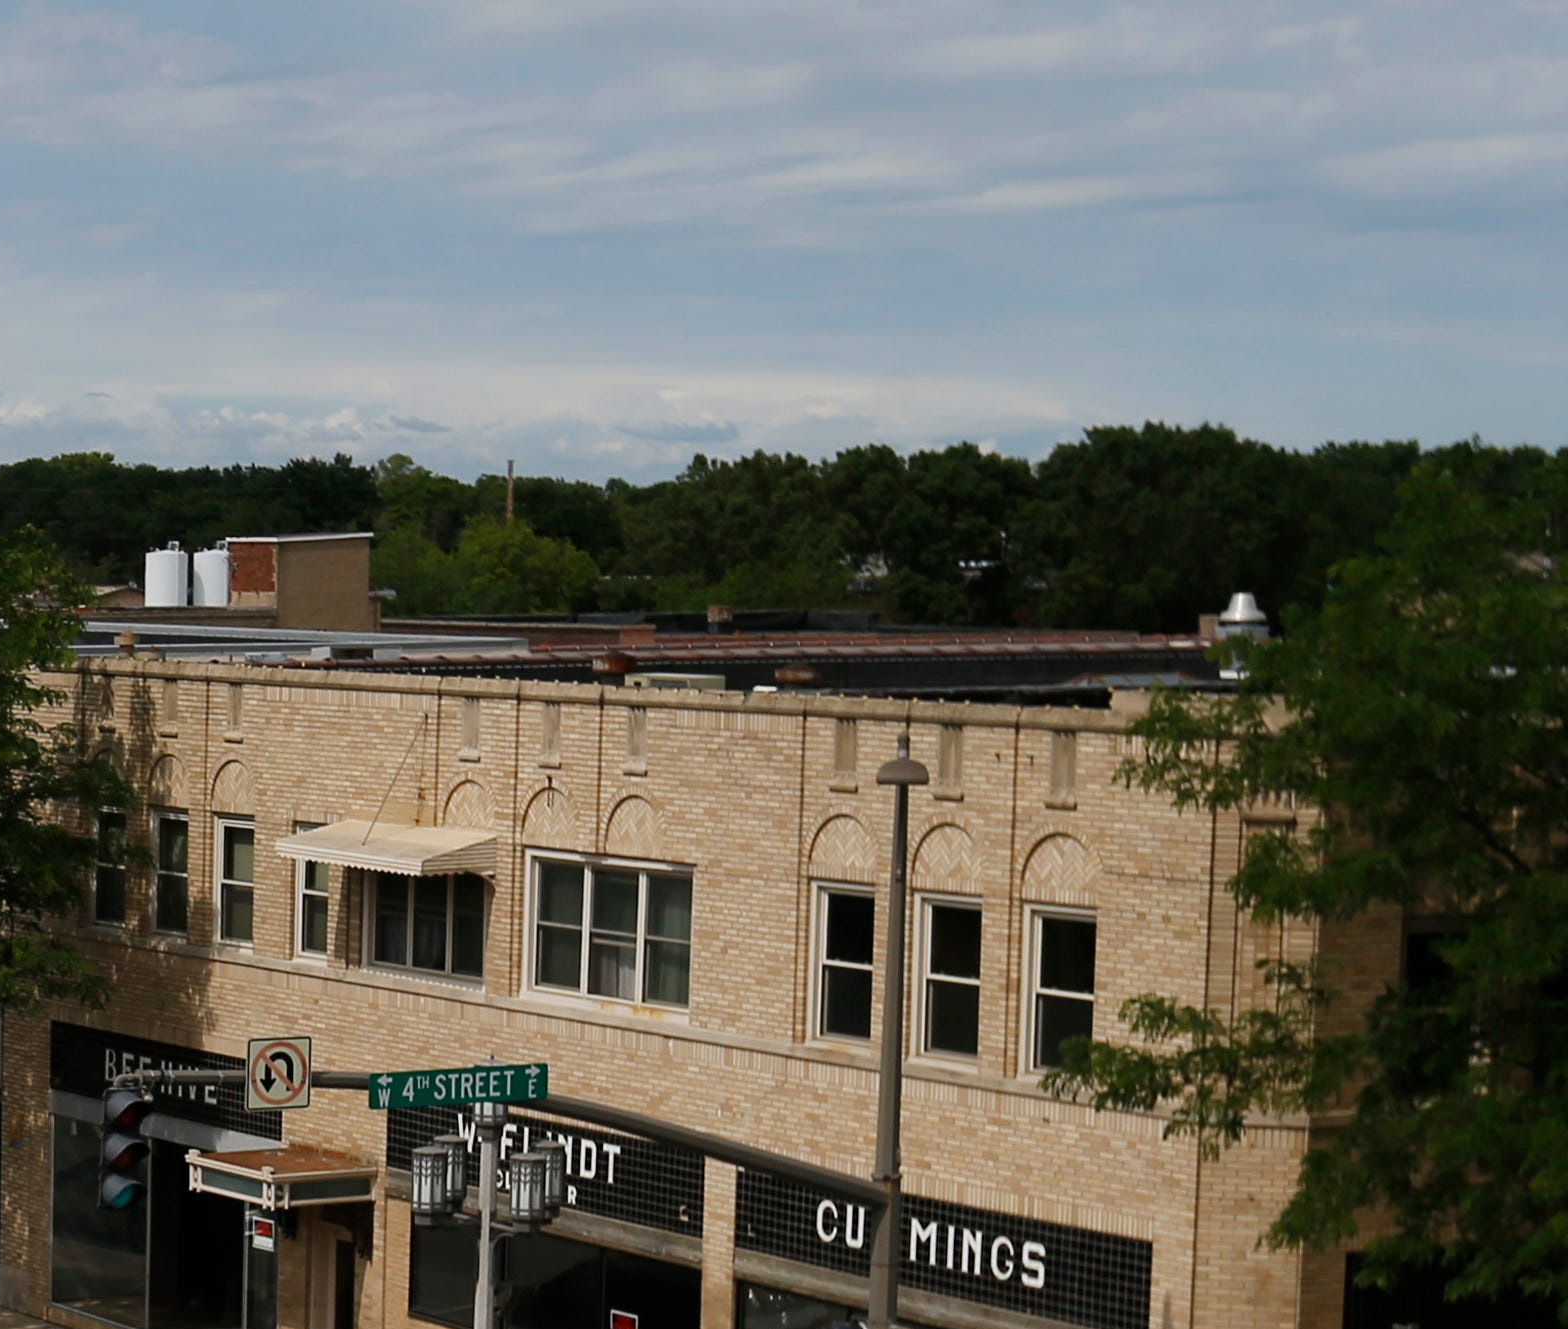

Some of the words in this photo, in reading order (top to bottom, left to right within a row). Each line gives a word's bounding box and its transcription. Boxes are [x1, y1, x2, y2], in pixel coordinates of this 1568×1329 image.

[378, 1088, 391, 1108] W
[402, 1075, 430, 1102] 4TH
[434, 1070, 515, 1100] STREET
[527, 1079, 537, 1099] E
[816, 1199, 1047, 1290] CUMINGS
